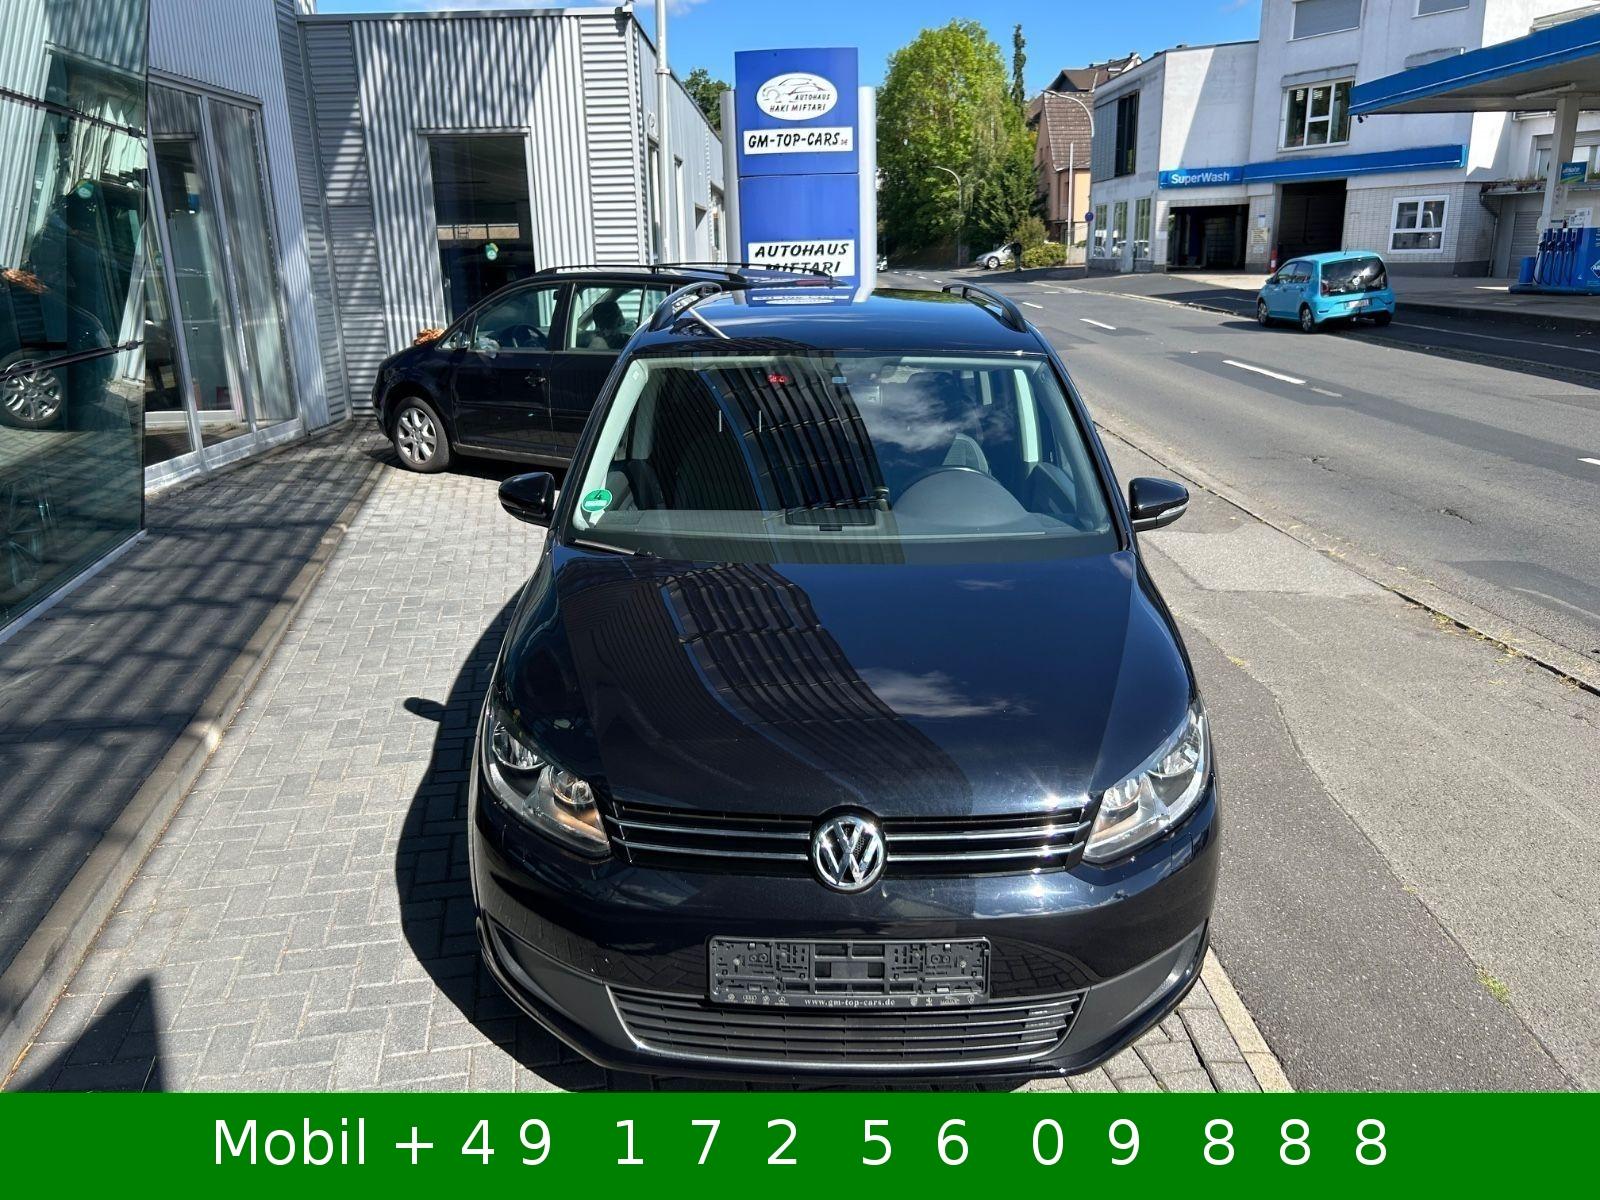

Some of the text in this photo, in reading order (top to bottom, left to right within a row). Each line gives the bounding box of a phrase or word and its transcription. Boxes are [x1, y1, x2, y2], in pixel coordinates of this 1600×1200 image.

[795, 93, 831, 101] AUTOHAUS
[769, 103, 826, 112] HAKI MIFTARI
[1171, 172, 1230, 185] SuperWash
[755, 243, 849, 258] AUTOHAUS
[804, 998, 896, 1008] www.gm-top-cars.de
